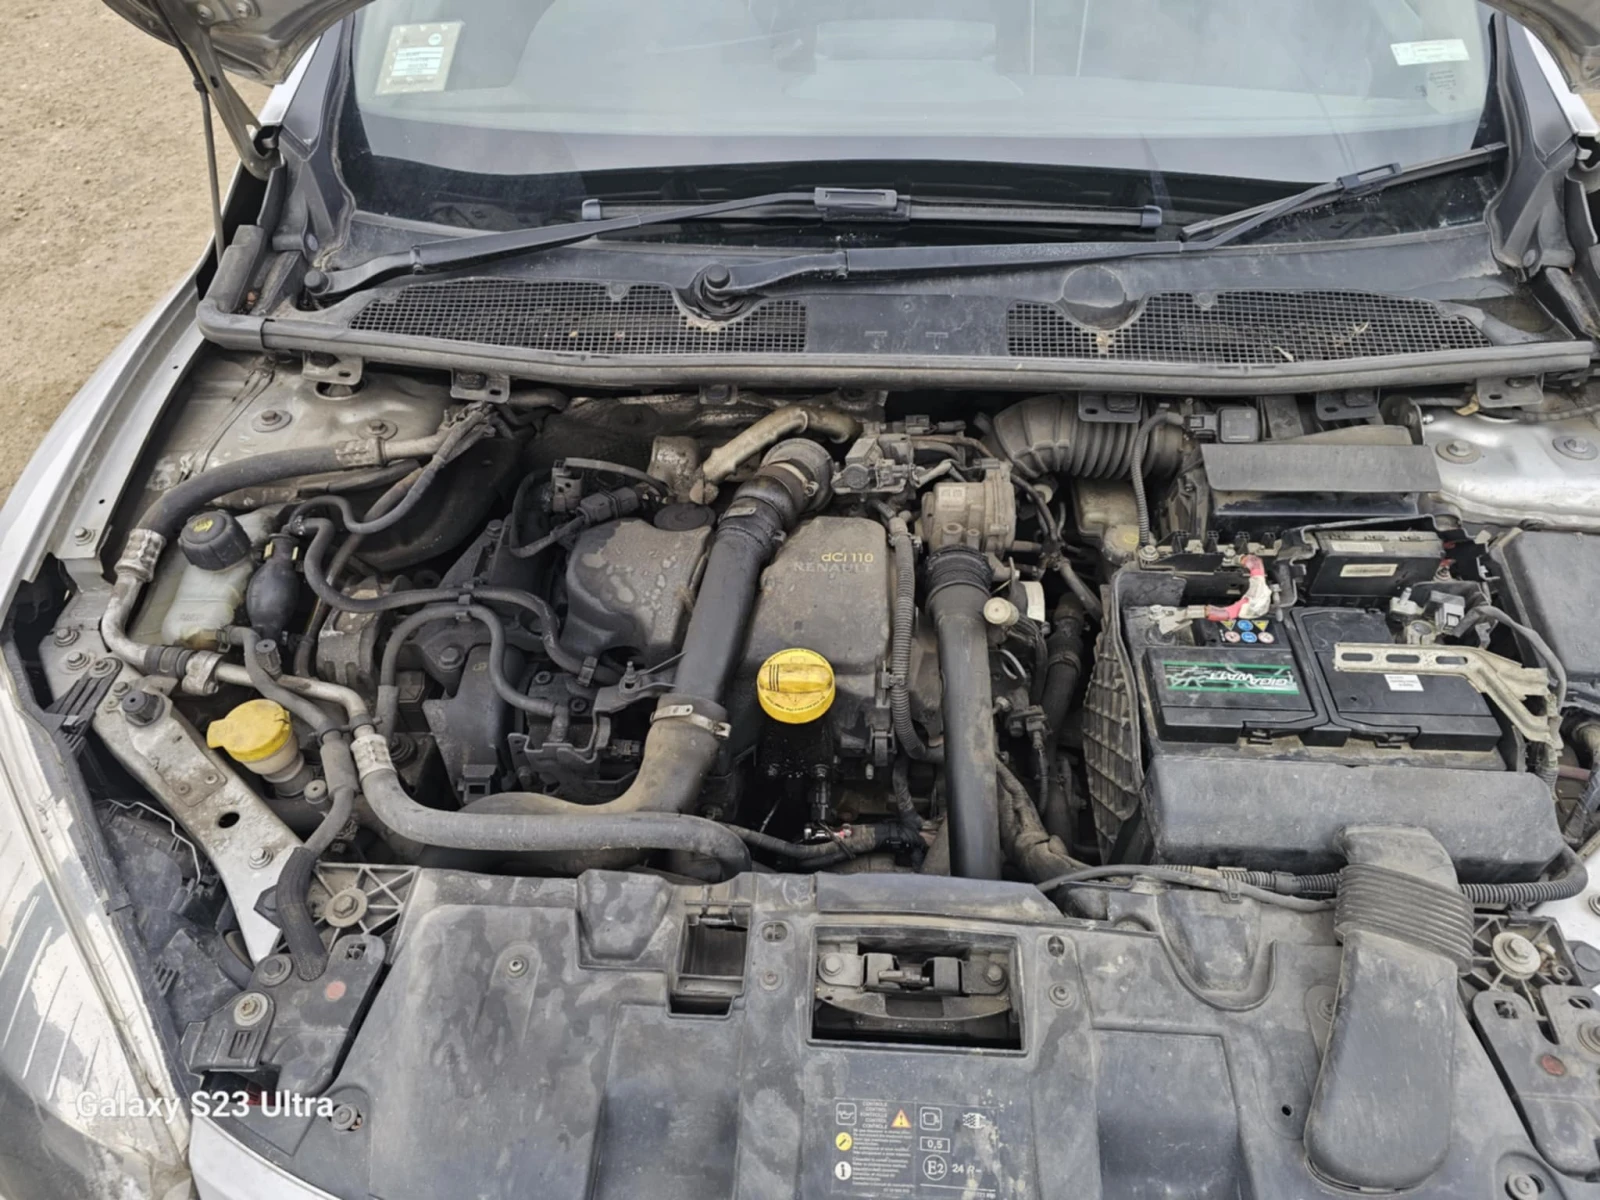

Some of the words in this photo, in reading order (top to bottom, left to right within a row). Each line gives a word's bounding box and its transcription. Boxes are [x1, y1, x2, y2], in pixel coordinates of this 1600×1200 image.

[821, 552, 847, 562] dCi
[850, 553, 874, 563] 110
[794, 563, 872, 573] RENAULT
[1206, 670, 1288, 686] GIGAWATT
[927, 1160, 945, 1175] E2
[951, 1163, 965, 1174] 24
